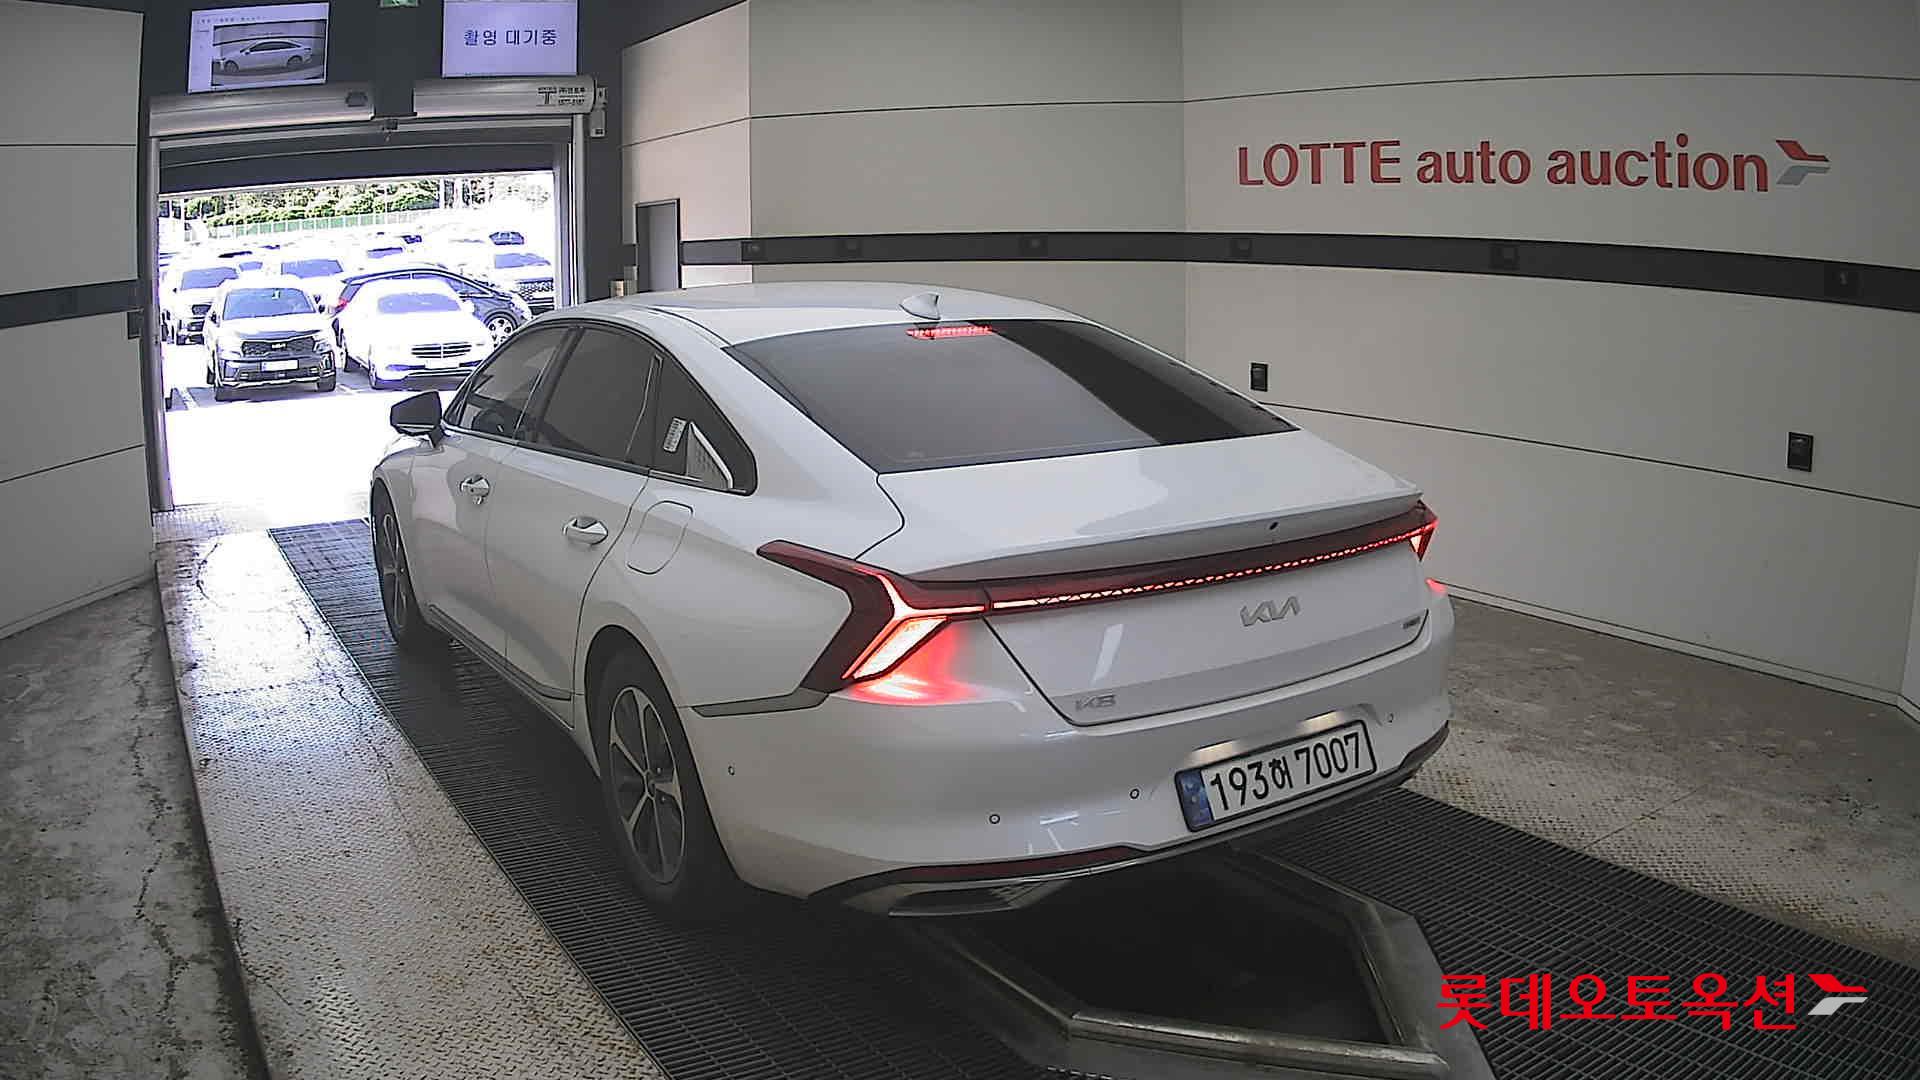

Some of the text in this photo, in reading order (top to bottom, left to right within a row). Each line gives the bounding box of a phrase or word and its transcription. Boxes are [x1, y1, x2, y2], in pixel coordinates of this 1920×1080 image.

[505, 29, 557, 46] 대기중
[1238, 132, 1769, 193] LOTTE auto auction
[1239, 595, 1300, 627] KIA
[1294, 732, 1360, 785] 7007
